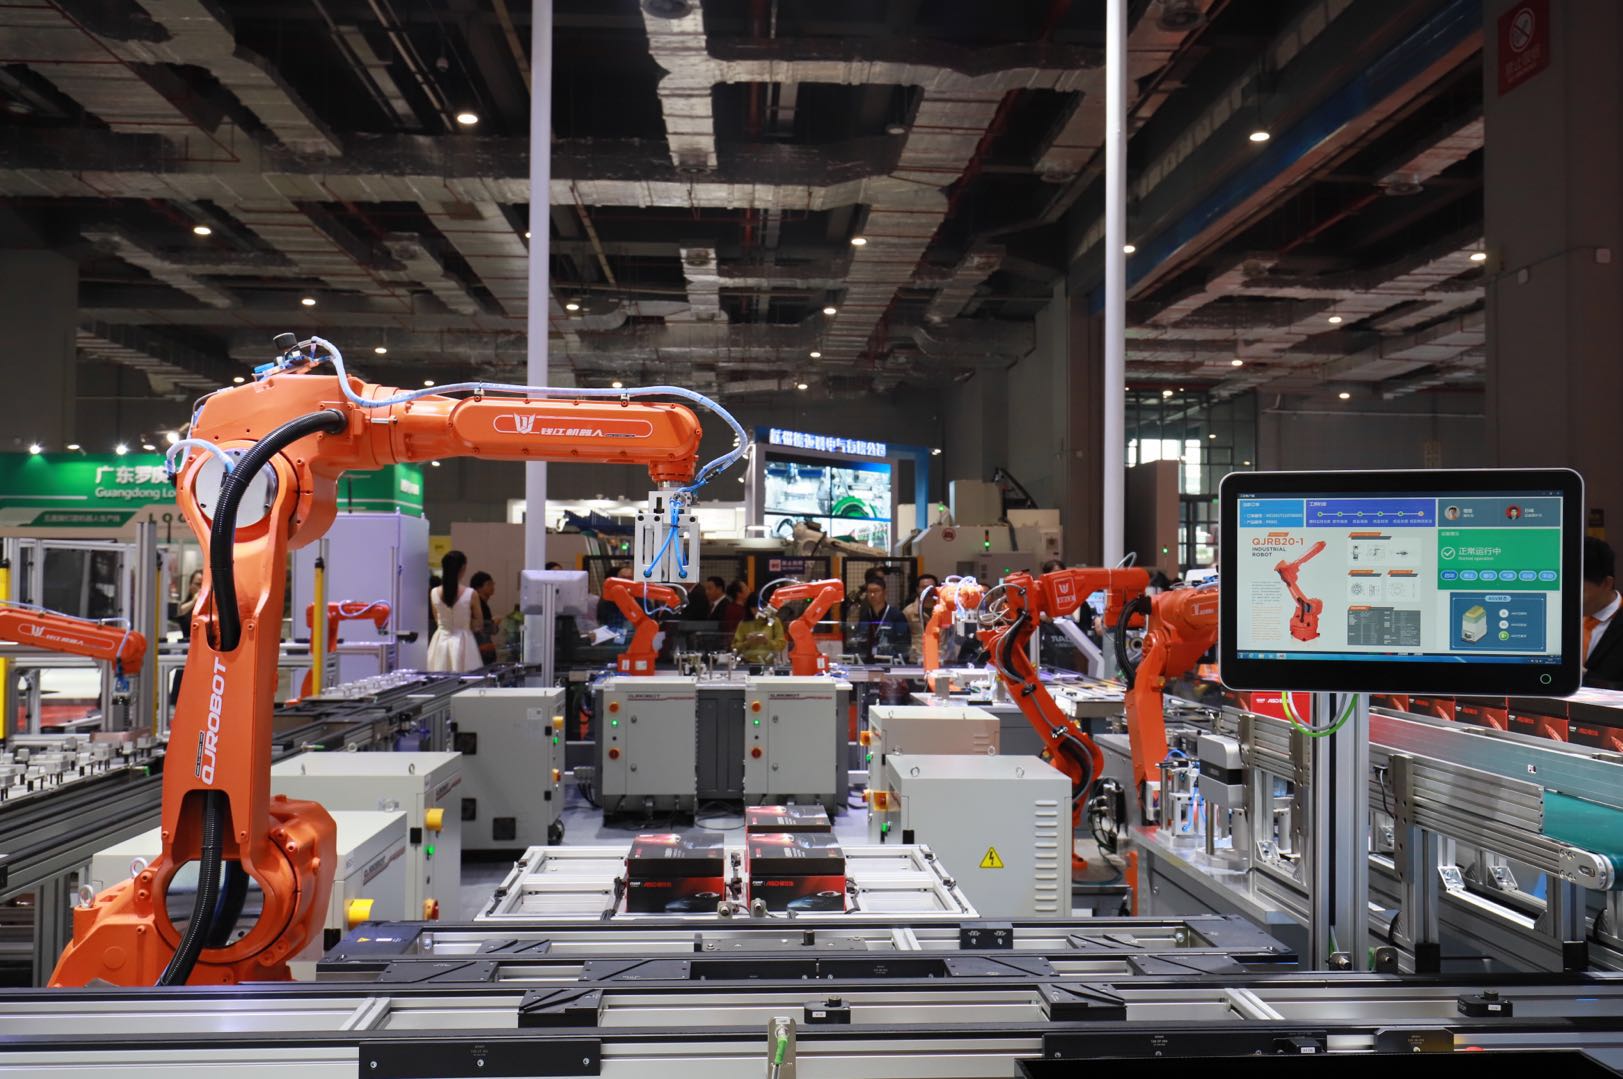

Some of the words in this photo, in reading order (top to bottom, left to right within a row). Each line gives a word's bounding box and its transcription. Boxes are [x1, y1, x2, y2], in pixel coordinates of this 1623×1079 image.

[541, 427, 603, 437] 钱江机器人
[95, 487, 160, 499] Guangdong
[1252, 538, 1304, 546] QJRB20-1
[1459, 547, 1502, 556] 正常运行中
[201, 656, 227, 785] QJROBOT
